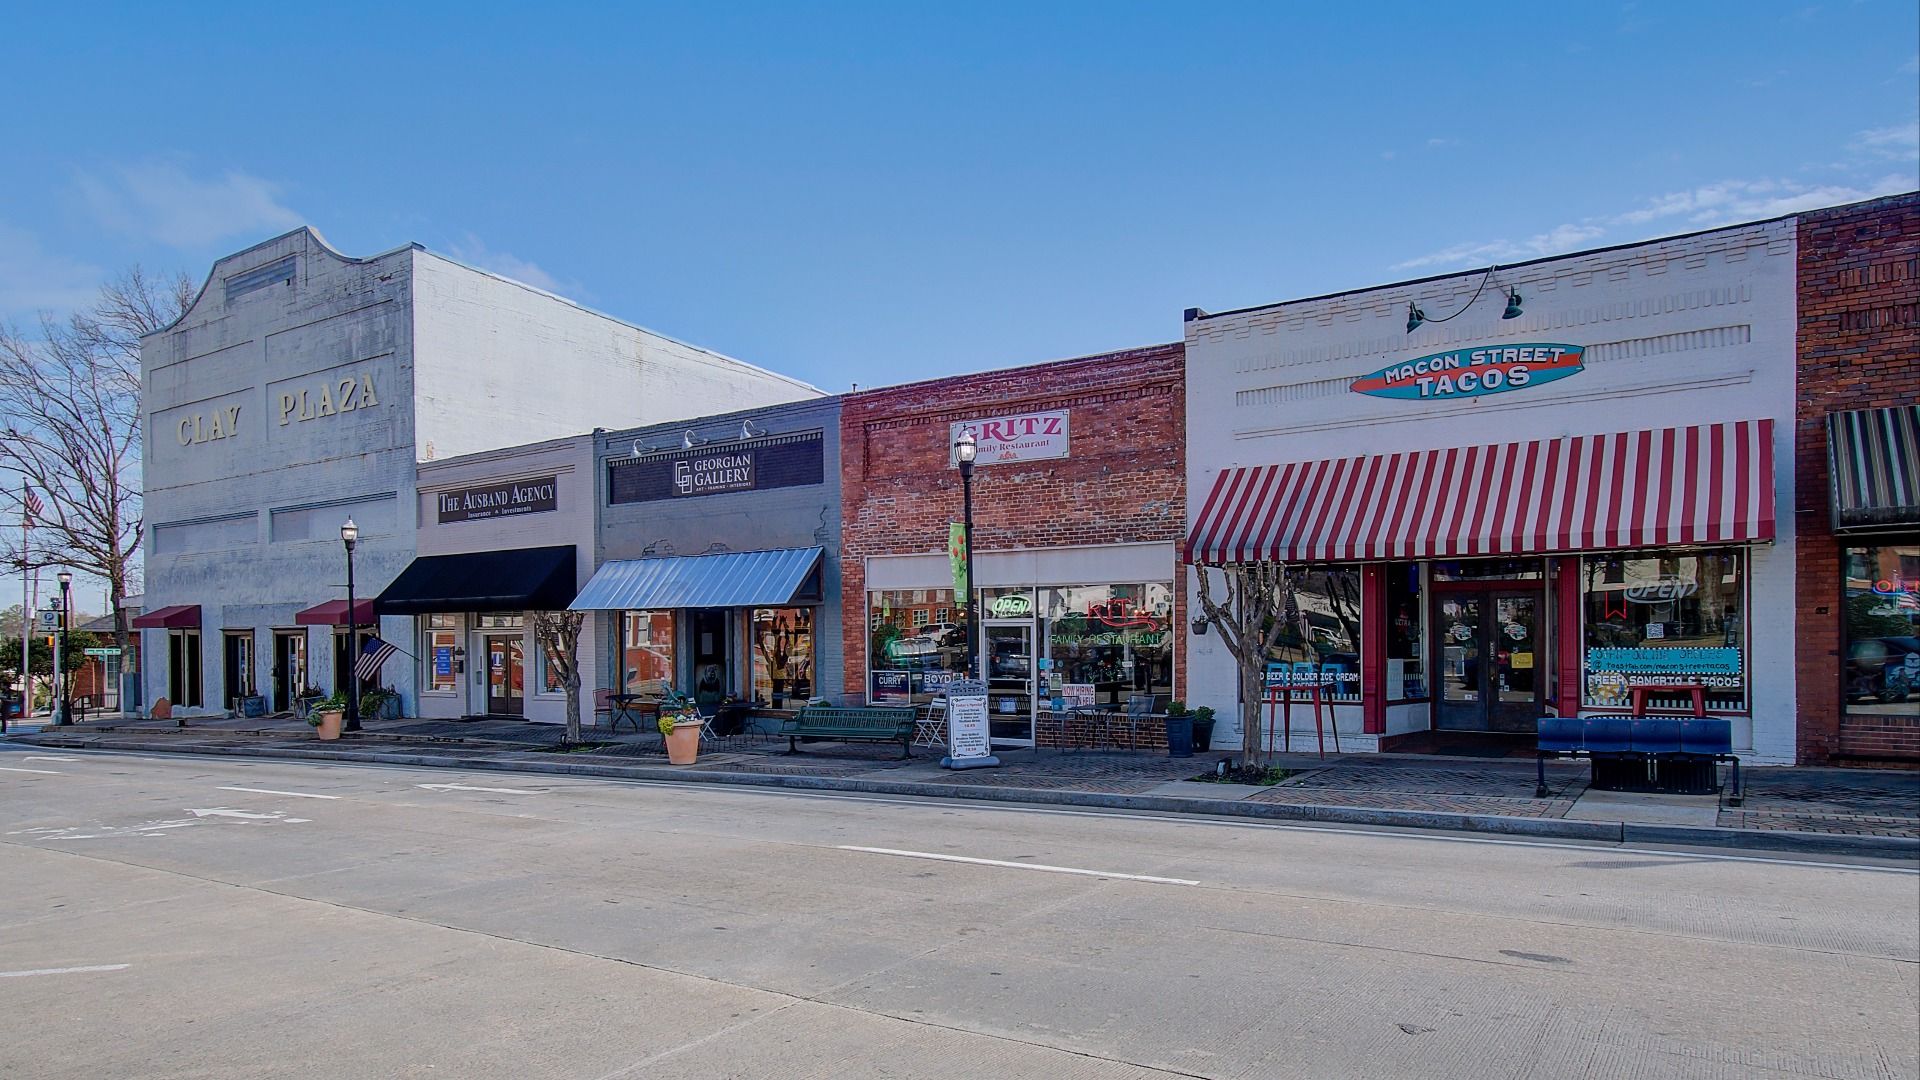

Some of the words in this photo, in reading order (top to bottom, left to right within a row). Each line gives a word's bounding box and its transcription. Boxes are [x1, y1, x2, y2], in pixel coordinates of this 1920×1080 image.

[1384, 353, 1460, 384] MACON
[1470, 347, 1566, 366] STREET
[1415, 365, 1531, 397] TACOS
[176, 404, 241, 446] CLAY
[278, 373, 379, 426] PLAZA
[958, 417, 1062, 442] GRITZ
[999, 440, 1050, 451] Restaurant
[694, 454, 751, 472] GEORGIAN
[694, 467, 751, 486] GALLERY
[439, 493, 460, 512] THE
[463, 490, 508, 510] AUSBAND
[511, 484, 555, 504] AGENCY
[1628, 581, 1686, 599] OPEN
[995, 598, 1028, 613] OPEN
[1051, 634, 1085, 645] FAMILY
[1088, 633, 1162, 645] RESTAURANT
[878, 676, 901, 685] CURRY
[924, 674, 952, 684] BOYD
[1266, 672, 1283, 680] BEER
[1292, 672, 1318, 680] COLDER
[1320, 672, 1334, 681] ICE
[1588, 675, 1625, 685] FRESH
[1700, 677, 1740, 687] TACOS
